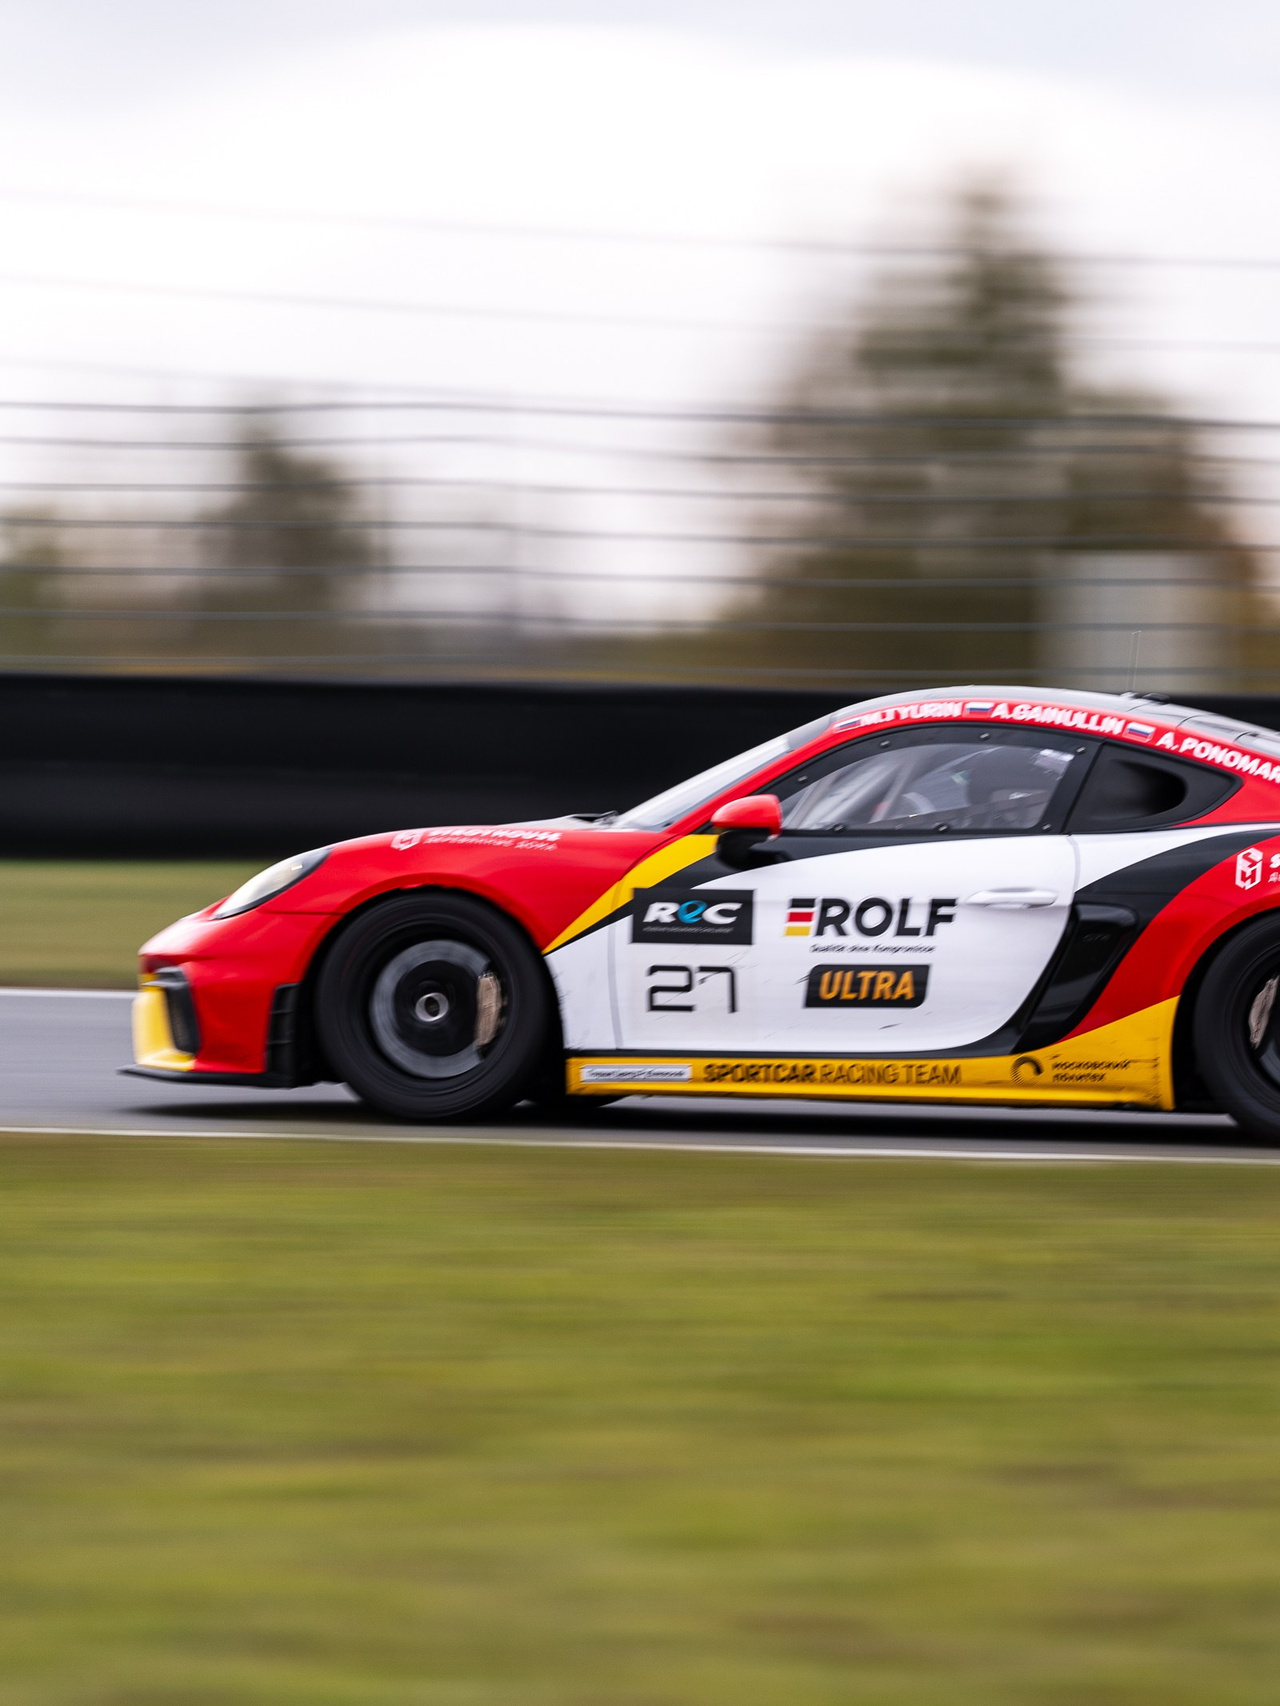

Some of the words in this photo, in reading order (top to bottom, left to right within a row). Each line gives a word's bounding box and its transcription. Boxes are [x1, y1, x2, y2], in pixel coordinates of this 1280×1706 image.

[815, 897, 959, 937] ROLF
[646, 964, 738, 1014] 27
[818, 970, 916, 1001] ULTRA
[703, 1063, 817, 1083] SPORTCAR
[819, 1063, 900, 1084] RACING
[902, 1063, 963, 1085] TEAM
